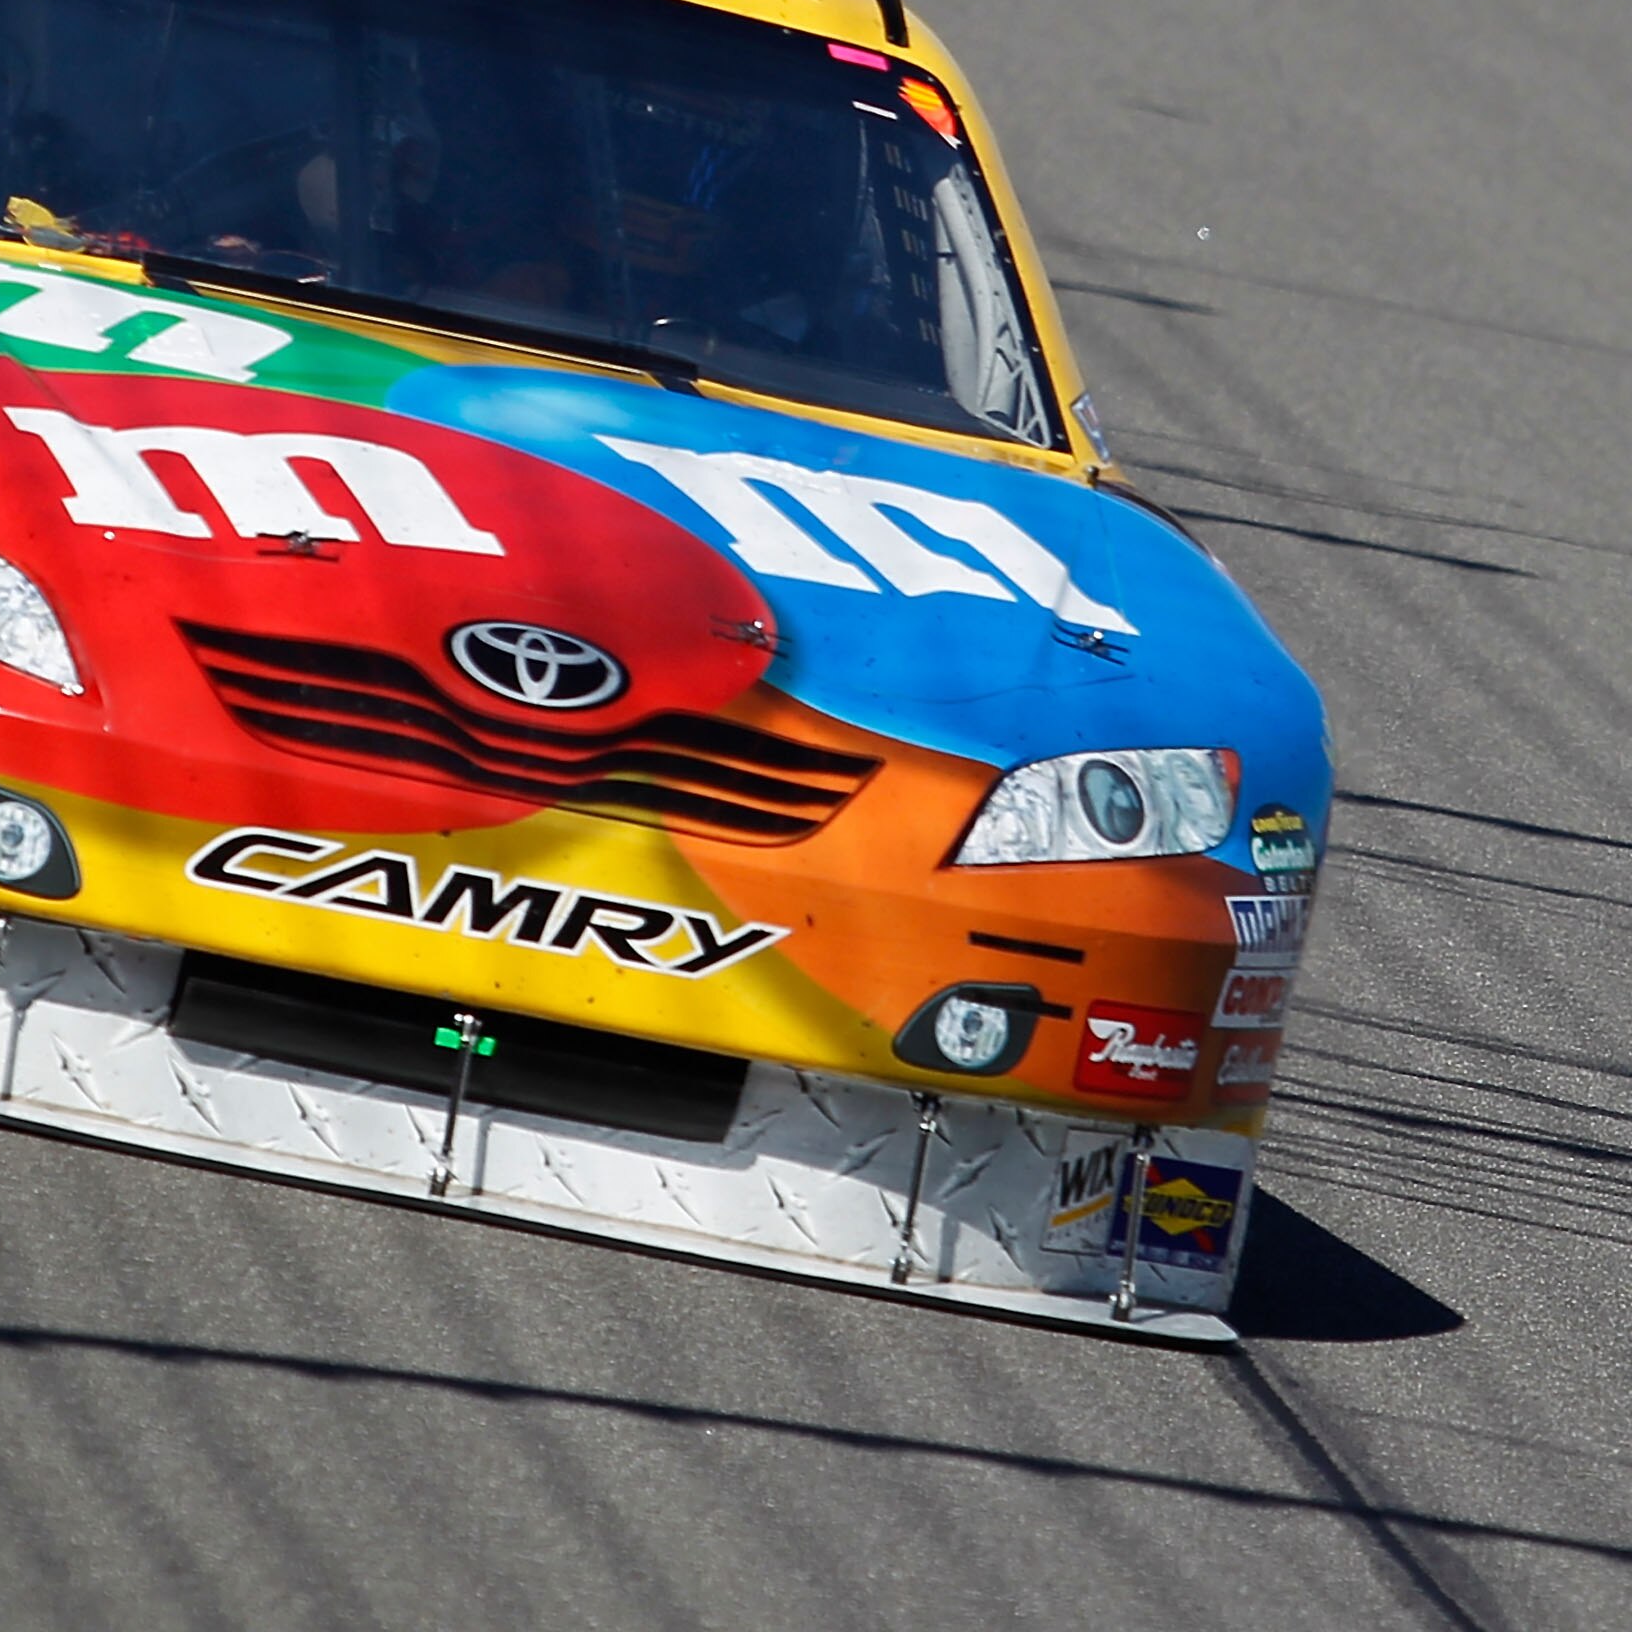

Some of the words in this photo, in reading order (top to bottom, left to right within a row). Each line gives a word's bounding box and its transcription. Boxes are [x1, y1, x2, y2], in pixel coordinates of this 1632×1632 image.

[2, 406, 506, 557] m
[594, 434, 1141, 636] m
[191, 833, 780, 974] CAMRY
[1136, 1190, 1232, 1223] UNOCO
